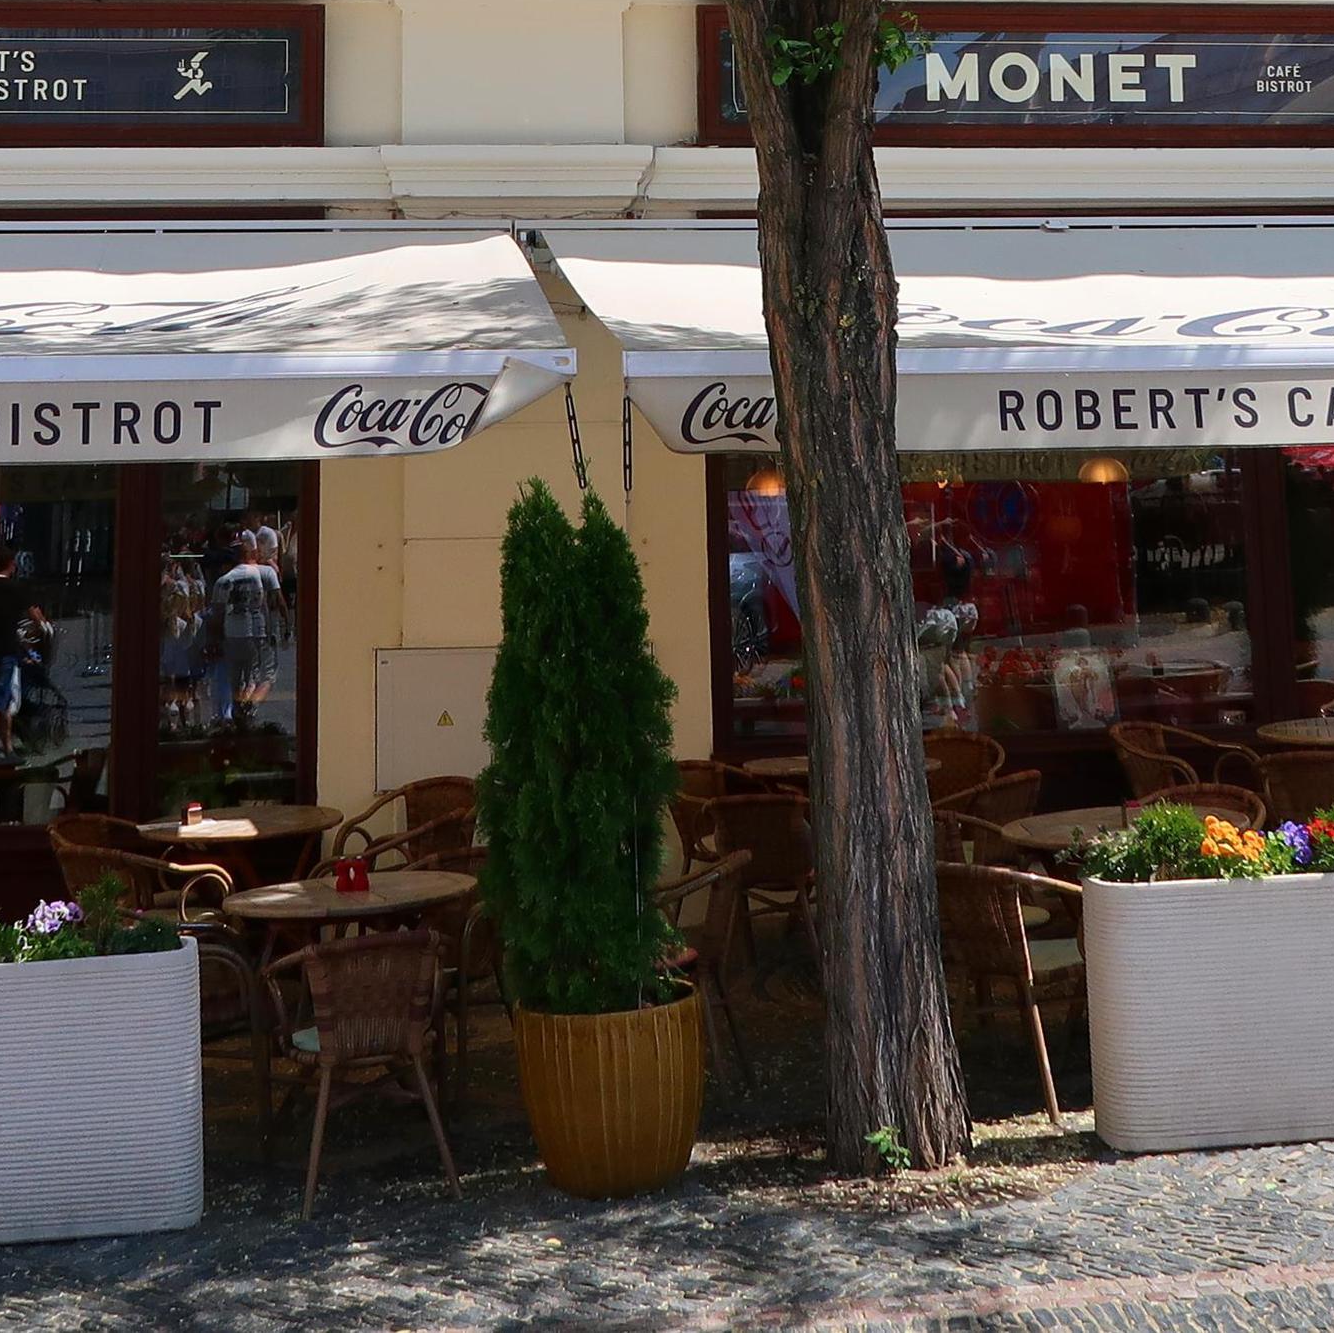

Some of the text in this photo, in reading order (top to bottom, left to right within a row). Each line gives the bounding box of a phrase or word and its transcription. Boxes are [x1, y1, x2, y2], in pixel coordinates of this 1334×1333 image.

[925, 51, 1198, 104] MONET
[1256, 80, 1313, 93] BISTROT
[1266, 63, 1302, 78] CAFÉ
[313, 382, 491, 448] Coca-Col
[997, 387, 1260, 433] ROBERT'S
